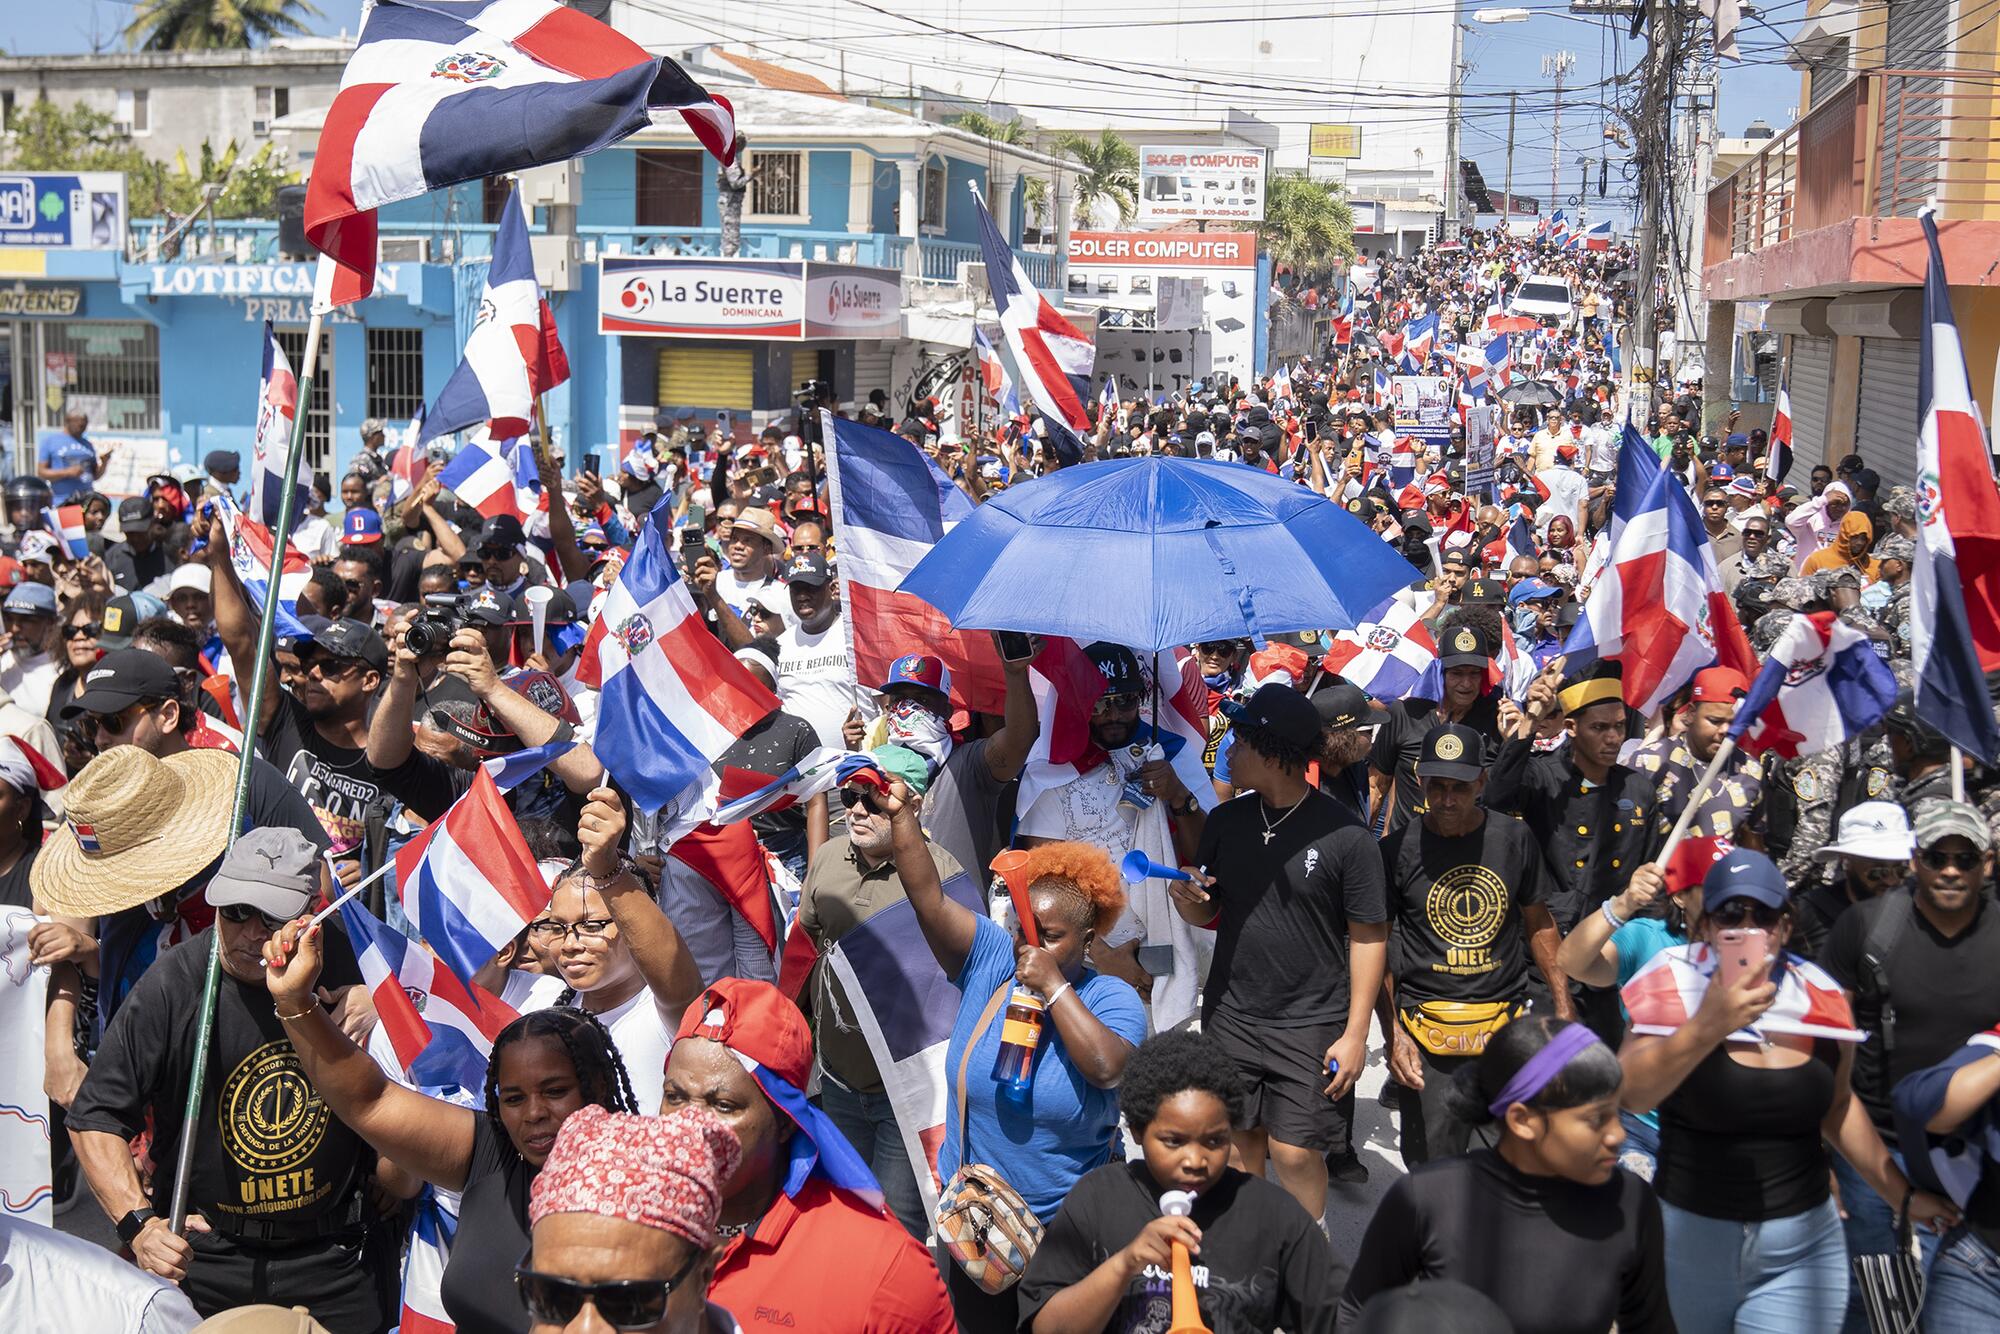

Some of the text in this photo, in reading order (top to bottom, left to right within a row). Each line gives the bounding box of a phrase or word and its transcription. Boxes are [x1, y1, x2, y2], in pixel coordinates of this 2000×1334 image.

[1146, 154, 1259, 168] SOLER COMPUTER
[1069, 240, 1239, 258] SOLER COMPUTER
[662, 280, 686, 302] La
[842, 283, 852, 303] La
[722, 307, 783, 318] DOMINICANA
[353, 516, 366, 531] D
[1473, 582, 1484, 597] LA
[779, 660, 802, 673] TRUE
[806, 654, 849, 670] RELIGION
[1098, 659, 1116, 679] NY
[455, 725, 490, 746] Canon
[258, 1059, 286, 1075] ORDEN
[238, 1112, 317, 1151] DEFENSA DE LA PATRIA
[240, 1167, 315, 1204] ÚNETE
[754, 1306, 796, 1328] FILA
